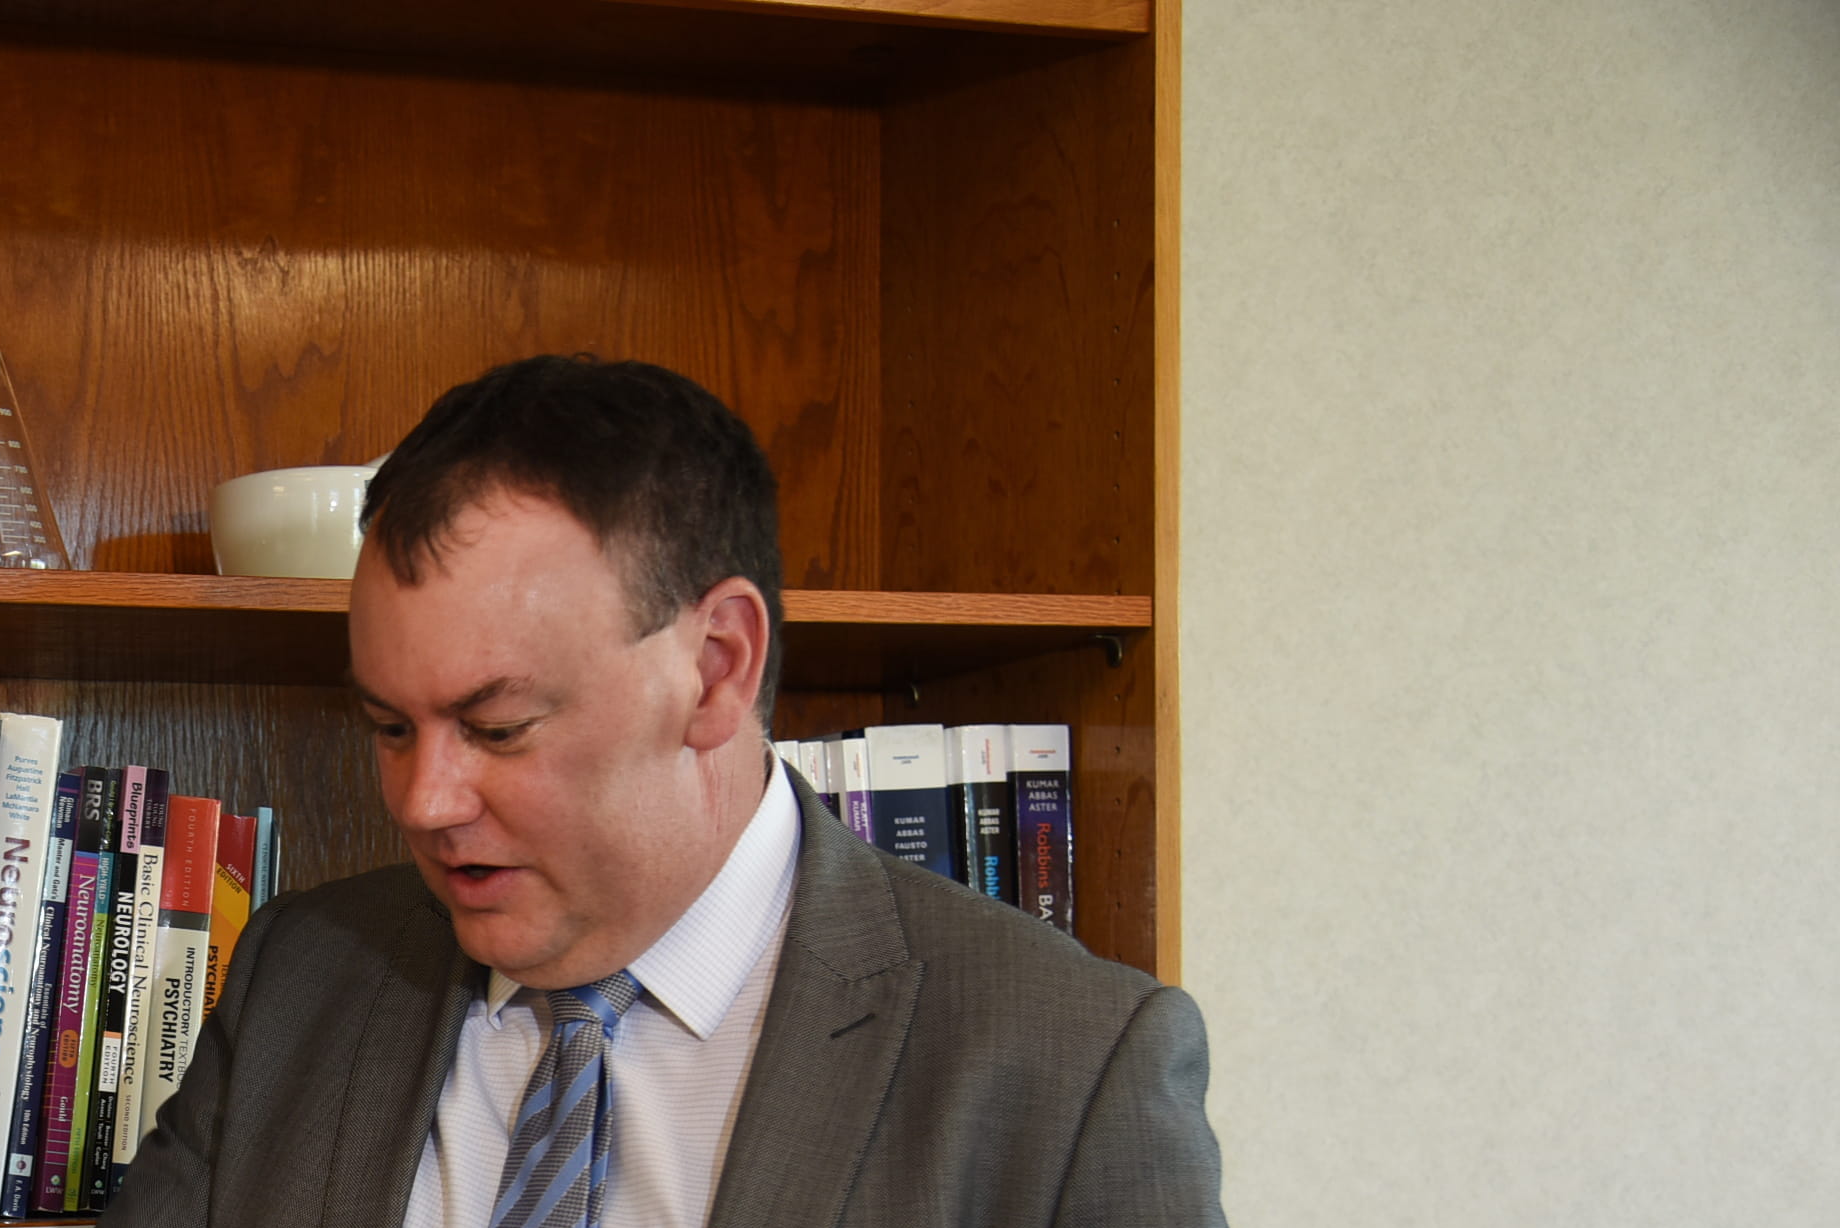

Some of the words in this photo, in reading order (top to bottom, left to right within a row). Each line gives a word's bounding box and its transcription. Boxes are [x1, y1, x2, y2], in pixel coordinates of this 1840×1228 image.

[7, 764, 43, 776] Augustine
[14, 755, 38, 766] Purves
[5, 773, 43, 786] Fitzpatrick
[16, 784, 30, 792] Hall
[1026, 779, 1059, 789] KUMAR
[2, 801, 40, 813] McNamara
[85, 779, 103, 821] BRS
[1028, 791, 1058, 800] ABBAS
[1028, 802, 1058, 812] ASTER
[125, 781, 143, 851] Blueprints
[894, 816, 926, 825] KUMAR
[894, 841, 928, 850] FAUSTO
[1036, 823, 1054, 889] Robbins
[98, 856, 109, 905] HIGH-YIELD
[140, 852, 159, 896] Basic
[216, 867, 242, 895] EDITION
[225, 863, 245, 884] SIXTH
[62, 873, 96, 1014] Neuroanatomy
[109, 890, 134, 994] NEUROLOGY
[135, 900, 154, 969] Clinical
[180, 946, 196, 1038] INTRODUCTORY
[124, 974, 147, 1085] Neuroscience
[158, 977, 181, 1083] PSYCHIATRY
[101, 1045, 111, 1085] EDITION
[109, 1046, 118, 1086] FOURTH
[58, 1096, 69, 1123] Gould
[124, 1094, 133, 1122] SECOND
[121, 1124, 130, 1151] EDITION
